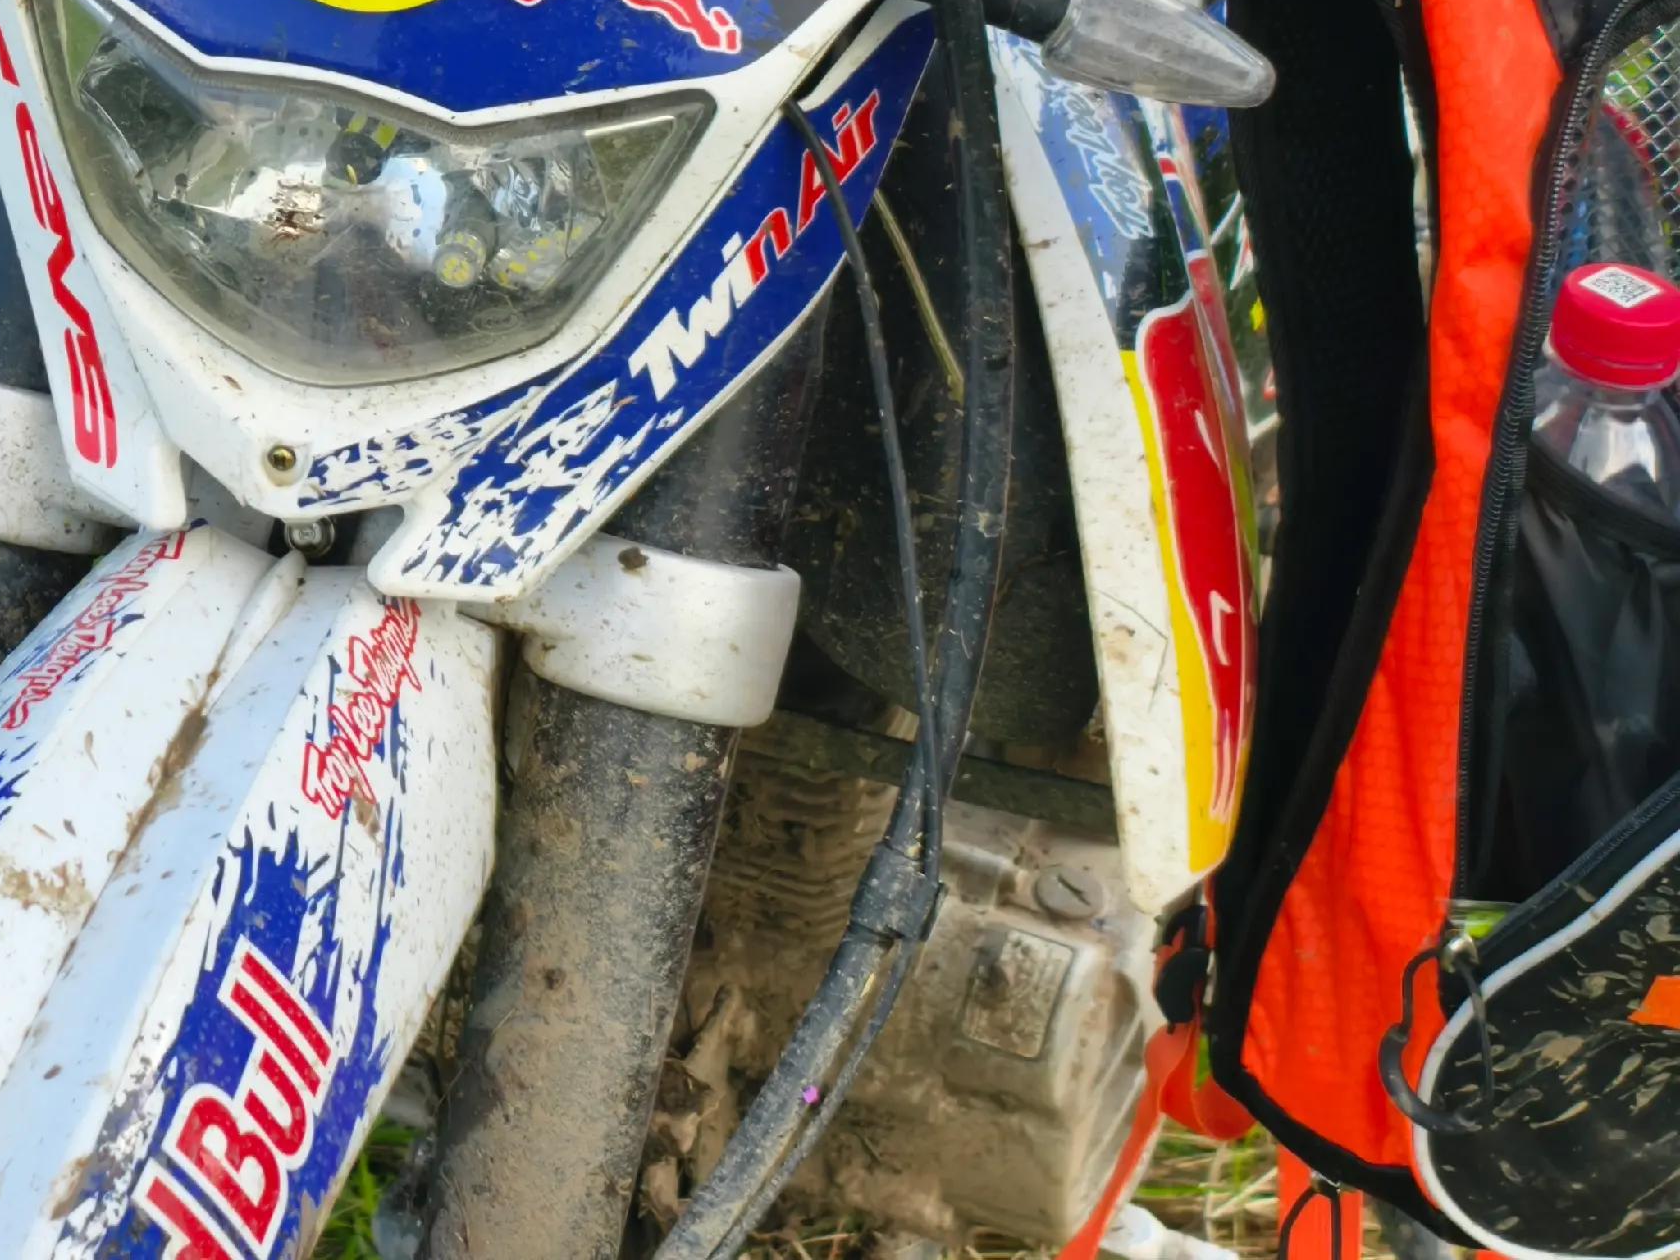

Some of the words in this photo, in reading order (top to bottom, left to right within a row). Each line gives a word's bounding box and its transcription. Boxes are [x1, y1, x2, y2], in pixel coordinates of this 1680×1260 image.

[794, 88, 881, 238] Air
[301, 741, 378, 820] Troy
[327, 703, 387, 762] Lee
[175, 949, 333, 1245] Bull
